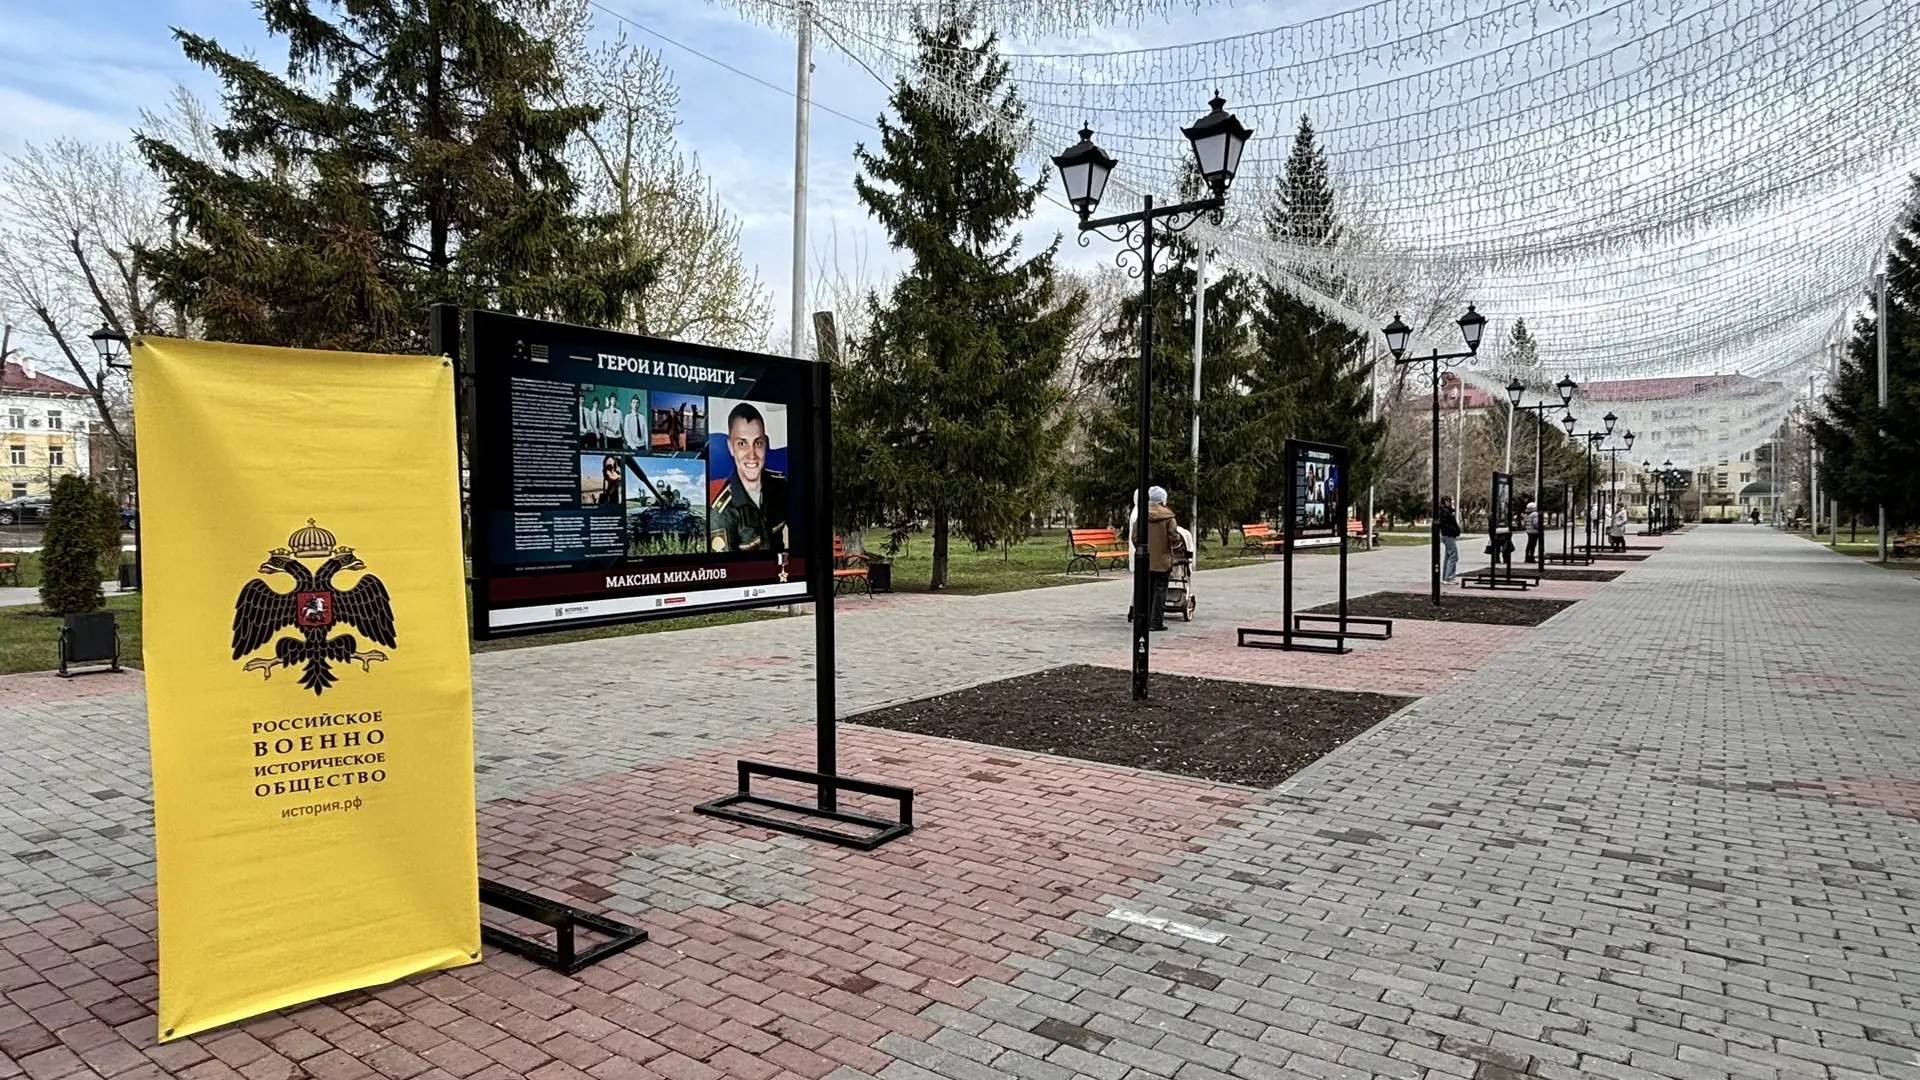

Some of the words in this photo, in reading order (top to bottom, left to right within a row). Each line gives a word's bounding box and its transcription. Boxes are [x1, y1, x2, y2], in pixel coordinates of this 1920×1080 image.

[597, 353, 652, 376] ГЕРОИ
[653, 359, 665, 376] И
[667, 362, 735, 385] ПОДВИГИ
[606, 572, 661, 588] МАКСИМ
[663, 567, 727, 584] МИХАЙЛОВ
[252, 711, 383, 734] РОССИЙСКОЕ
[253, 729, 385, 757] ВОЕННО
[254, 752, 386, 777] ИСТОРИЧЕСКОЕ
[254, 769, 387, 798] ОБЩЕСТВО
[281, 795, 363, 818] история.рф
